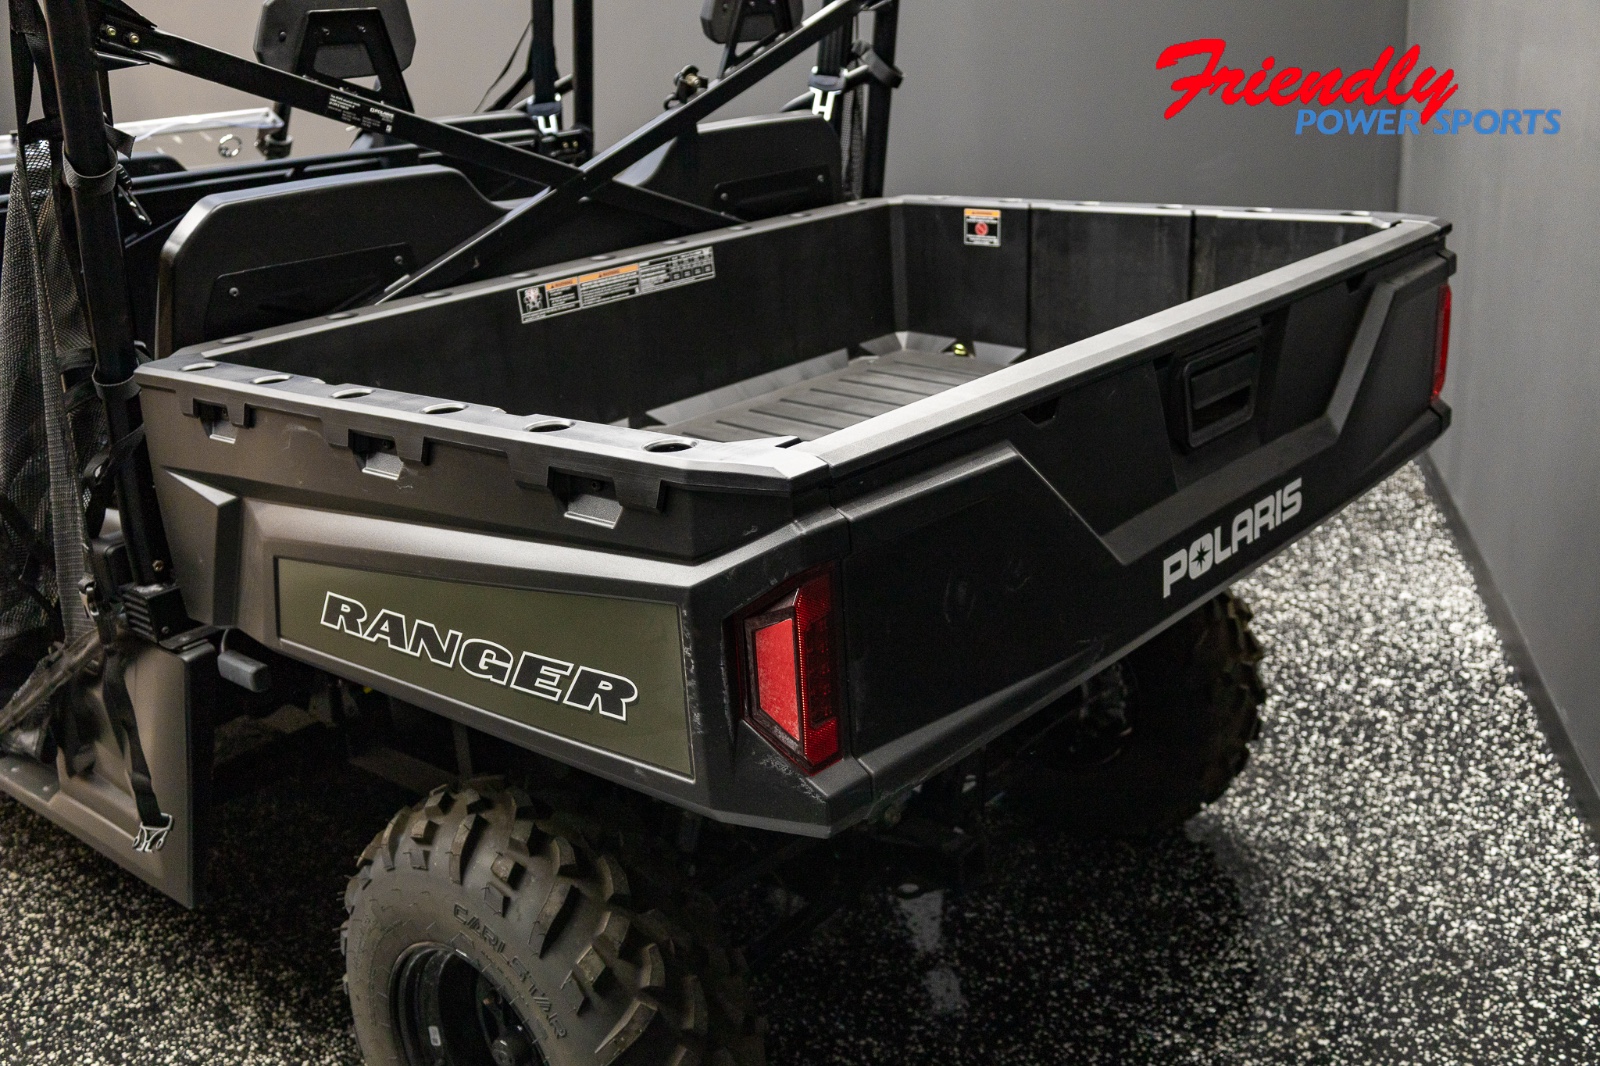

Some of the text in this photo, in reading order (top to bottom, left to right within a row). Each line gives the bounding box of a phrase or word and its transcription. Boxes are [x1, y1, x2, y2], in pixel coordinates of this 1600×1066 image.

[1163, 477, 1302, 599] POLARIS
[320, 591, 638, 721] RANGER
[453, 903, 568, 1039] CARLSTAR
